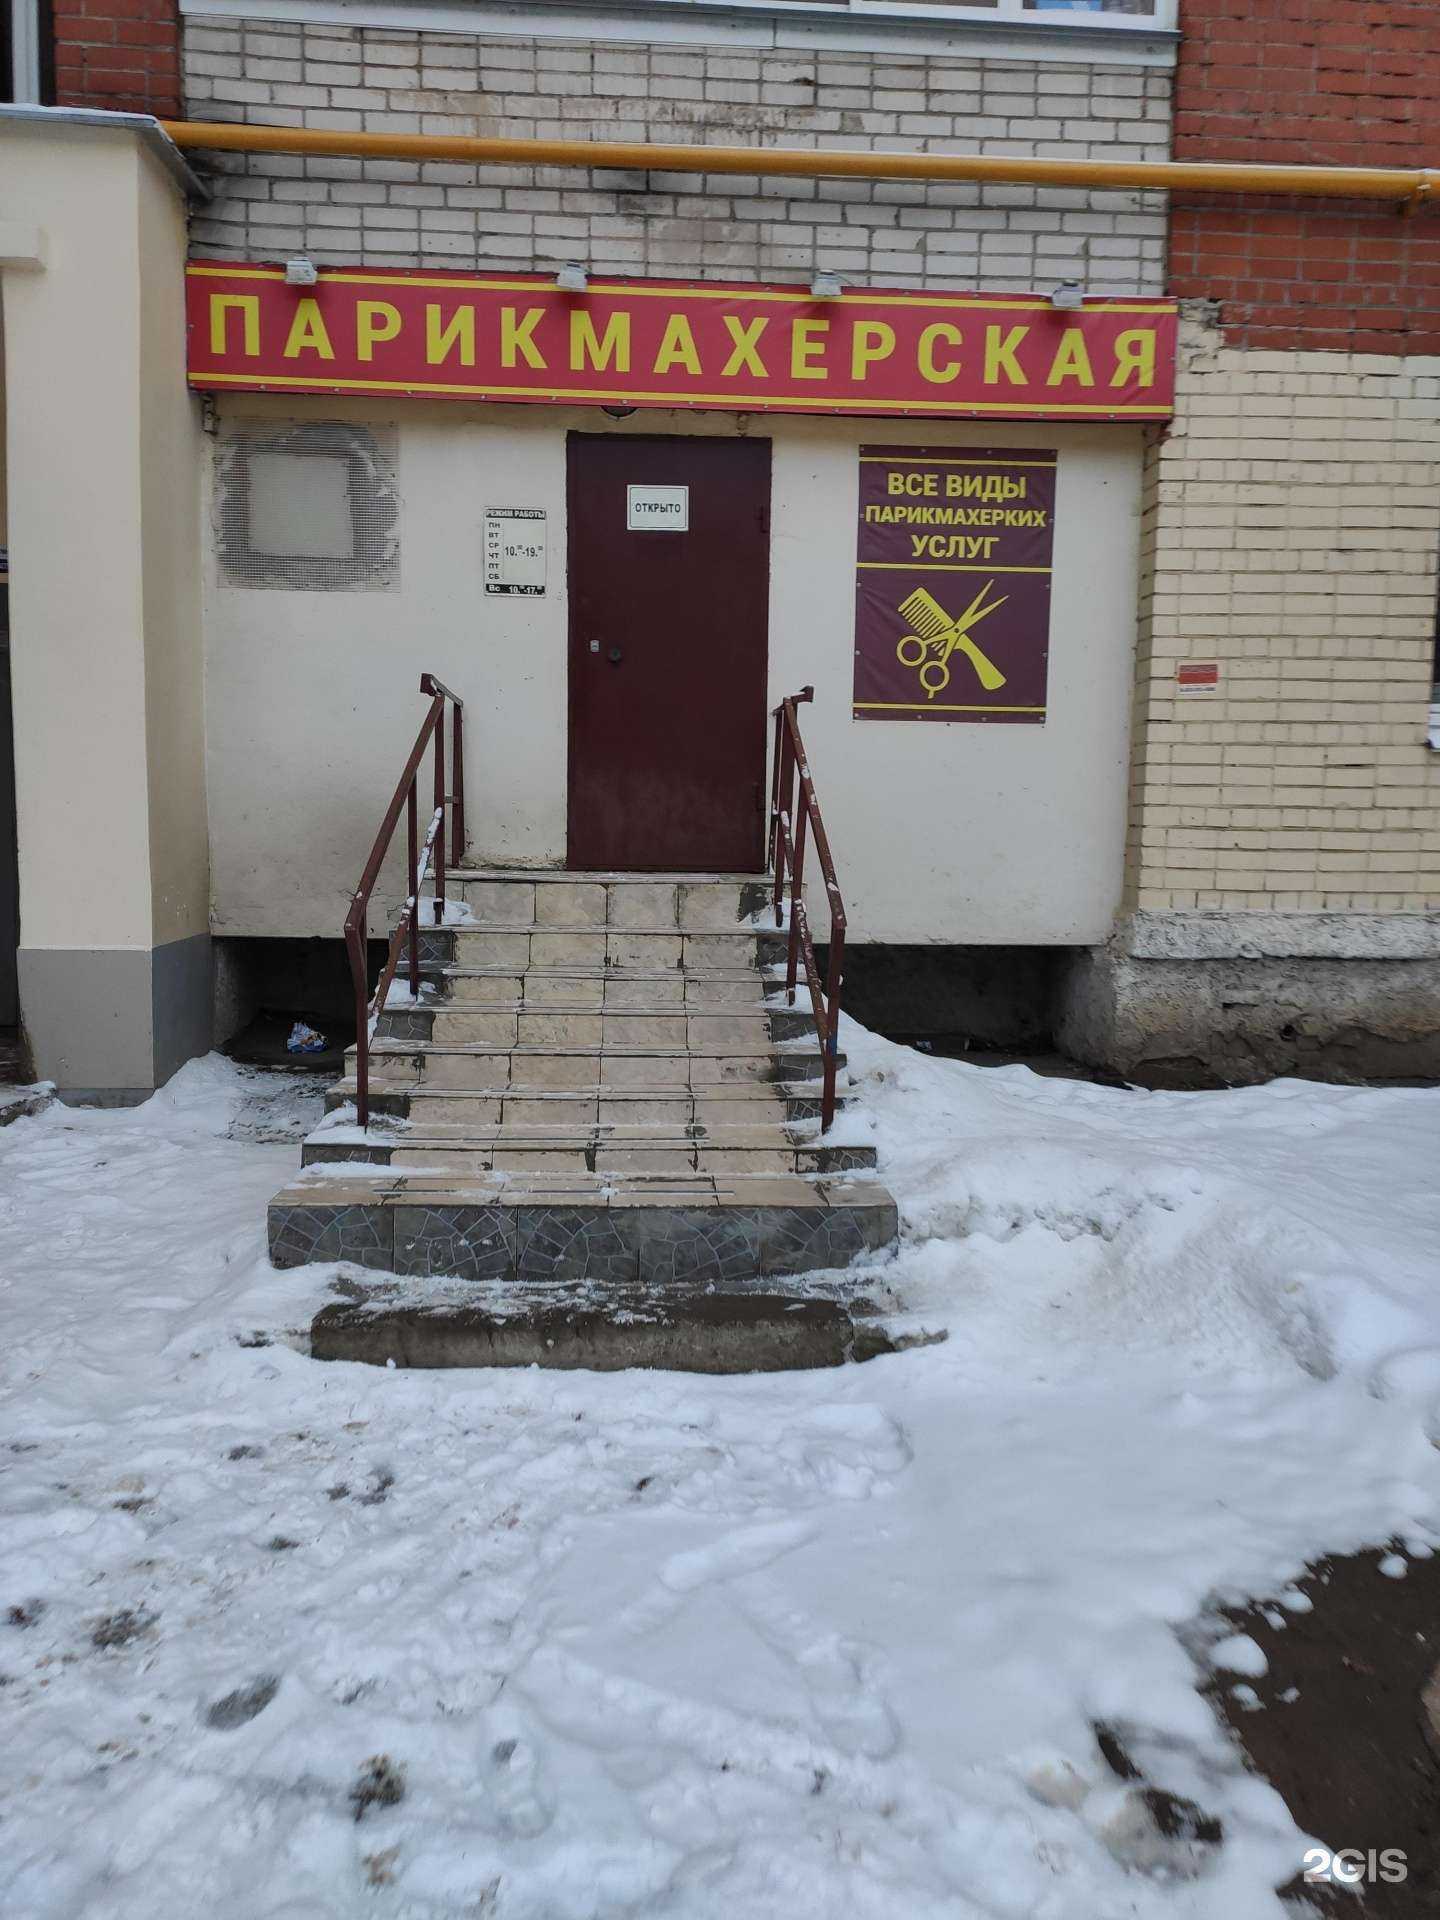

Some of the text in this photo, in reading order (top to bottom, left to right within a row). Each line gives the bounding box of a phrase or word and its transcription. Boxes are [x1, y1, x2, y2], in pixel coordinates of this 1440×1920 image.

[209, 293, 1157, 388] ПАРИКМАХЕРСКАЯ
[887, 472, 1027, 503] ВСЕ ВИДЫ
[514, 510, 545, 518] РАБОТЫ
[634, 502, 681, 513] ОТКРЫТО
[865, 505, 1047, 528] ПАРИКМАХЕРКИХ
[911, 534, 1000, 559] УСЛУГ
